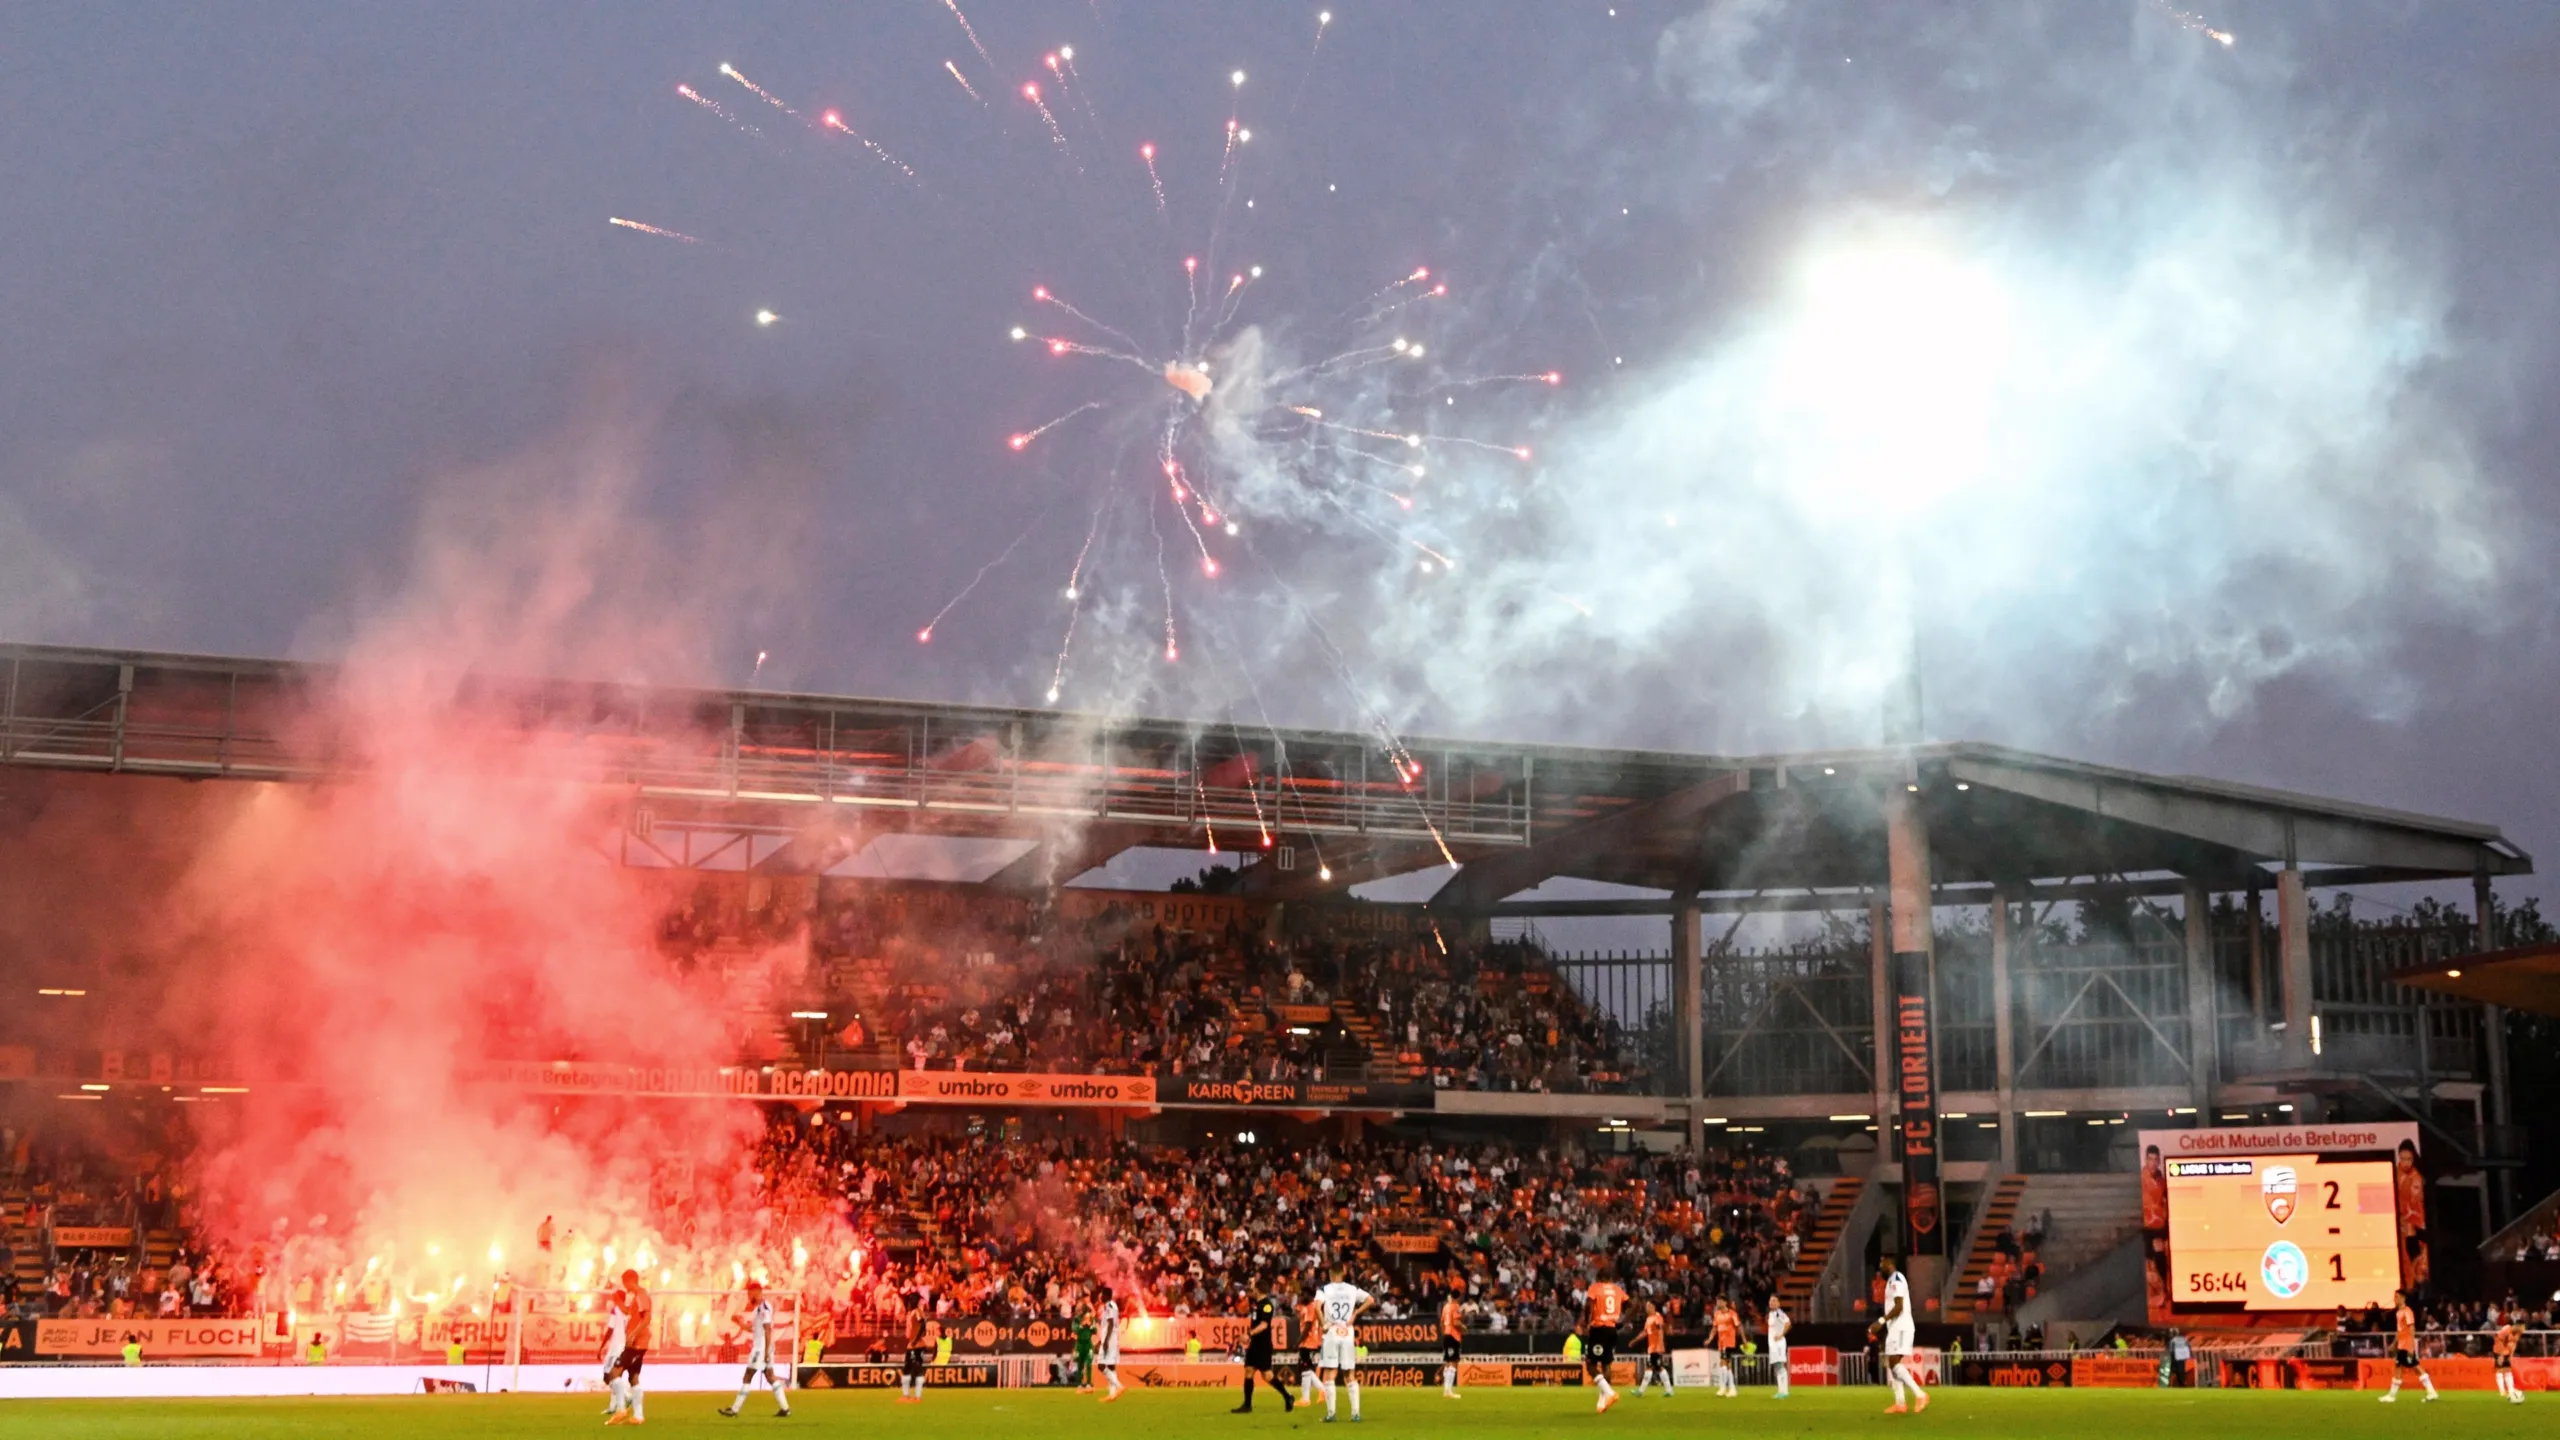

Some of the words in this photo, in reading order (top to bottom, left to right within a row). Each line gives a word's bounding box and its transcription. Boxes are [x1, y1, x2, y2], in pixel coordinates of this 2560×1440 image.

[1900, 995, 1930, 1110] LORIENT
[771, 1070, 895, 1096] ACADOMIA
[938, 1078, 1009, 1098] umbro
[1050, 1081, 1119, 1101] umbro
[1188, 1081, 1295, 1103] KARRGREEN
[1905, 1120, 1933, 1156] FC
[2179, 1134, 2225, 1150] Crédit
[2229, 1132, 2280, 1149] Mutuel
[2283, 1132, 2302, 1147] de
[2305, 1130, 2377, 1149] Bretagne
[2323, 1180, 2341, 1209] 2
[2329, 1253, 2346, 1281] 1
[2190, 1272, 2247, 1293] 56:44
[1331, 1302, 1350, 1322] 32
[1605, 1296, 1616, 1314] 9
[0, 1327, 23, 1349] A
[87, 1327, 153, 1346] JEAN
[168, 1329, 256, 1345] FLOCH
[977, 1325, 994, 1337] hit
[999, 1327, 1026, 1341] 91.4
[1031, 1326, 1048, 1337] hit
[1353, 1324, 1438, 1343] ORTINGSOLS
[922, 1367, 988, 1385] MERLIN
[1355, 1365, 1425, 1387] arrelage
[1513, 1367, 1582, 1383] Aménageur
[1988, 1366, 2041, 1386] umbro
